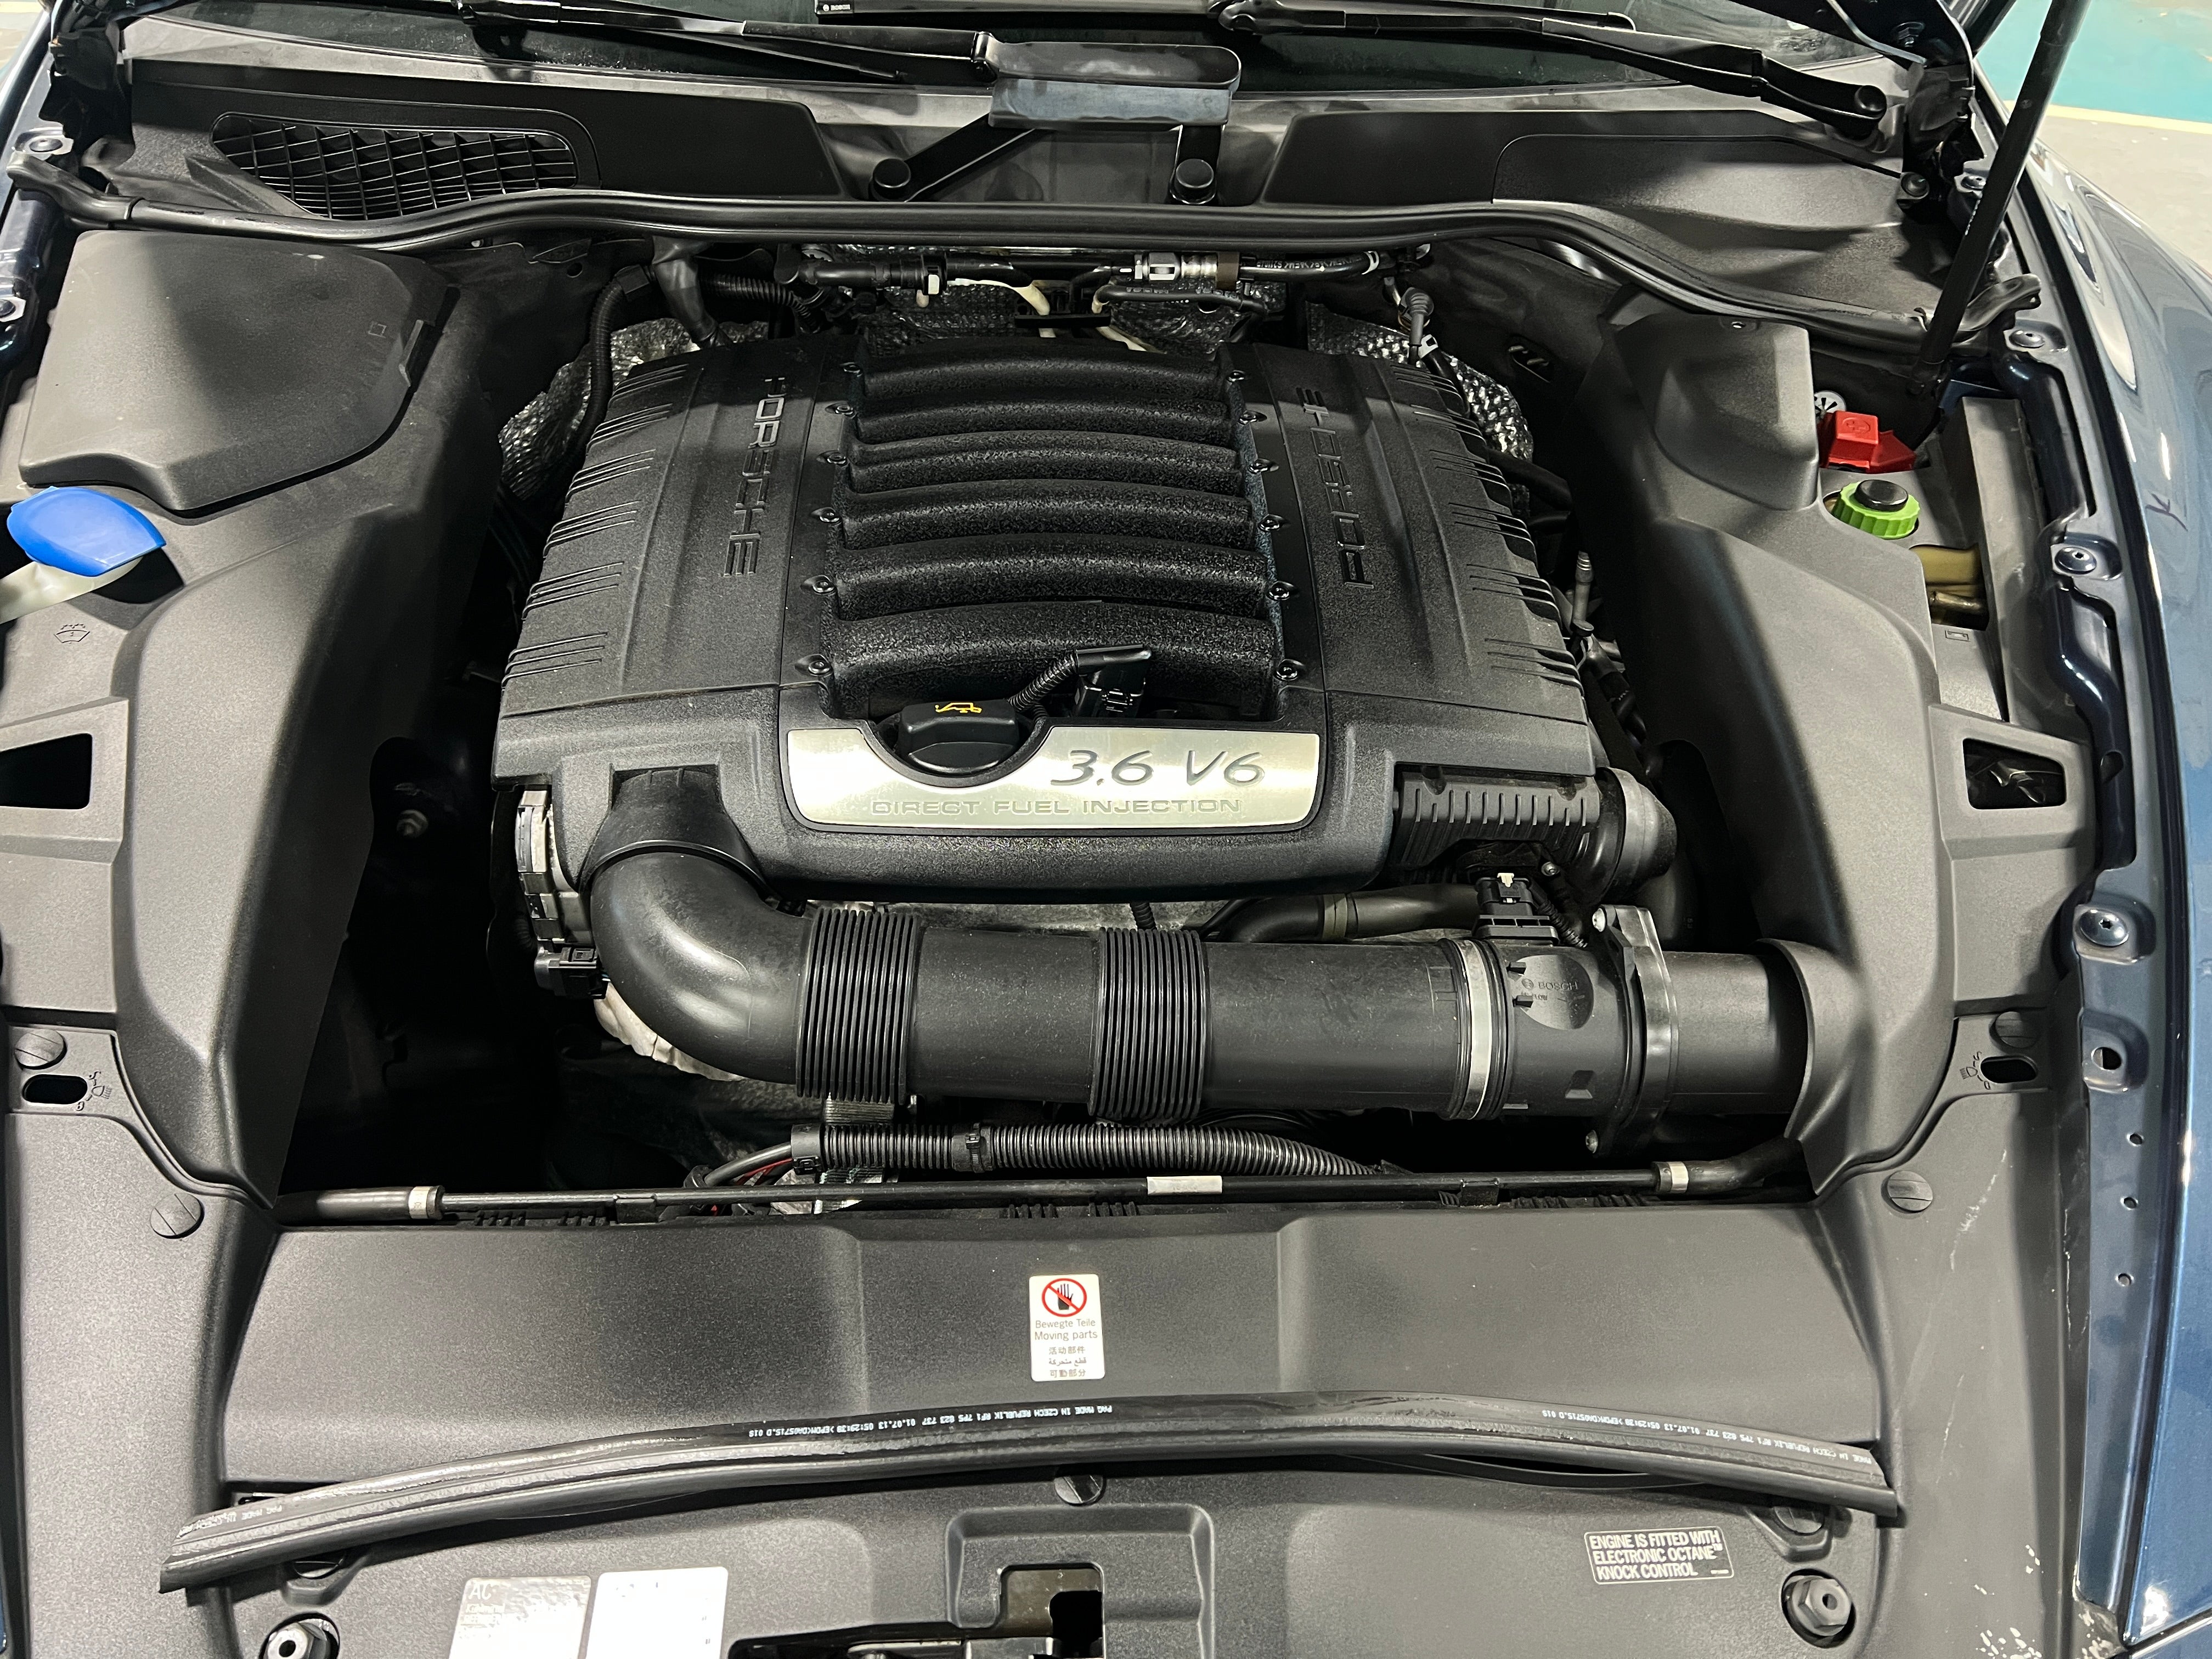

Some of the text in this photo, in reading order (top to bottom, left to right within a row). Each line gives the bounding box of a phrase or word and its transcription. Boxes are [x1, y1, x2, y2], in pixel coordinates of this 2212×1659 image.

[723, 377, 786, 576] PORSCHE
[1296, 387, 1374, 588] PORSCHE
[1050, 749, 1265, 787] 3.6 V6
[871, 798, 1242, 815] DIRECT FUEL INJECTION
[1538, 980, 1578, 990] BOSCH
[1035, 1318, 1096, 1329] Bewegte Teile
[1035, 1330, 1098, 1341] Moving parts
[994, 1410, 1031, 1420] REPUBLIK
[1034, 1408, 1058, 1418] CZECH
[1061, 1407, 1071, 1416] IN
[1075, 1406, 1094, 1415] MADE
[878, 1418, 916, 1428] 01.07.13
[922, 1416, 937, 1425] 737
[1664, 1423, 1700, 1435] 01.07.13
[1589, 1530, 1721, 1550] ENGINE IS FITTED WITH
[1592, 1548, 1667, 1565] ELECTRONIC
[1596, 1562, 1699, 1580] KNOCK CONTROL
[468, 1583, 492, 1600] AC
